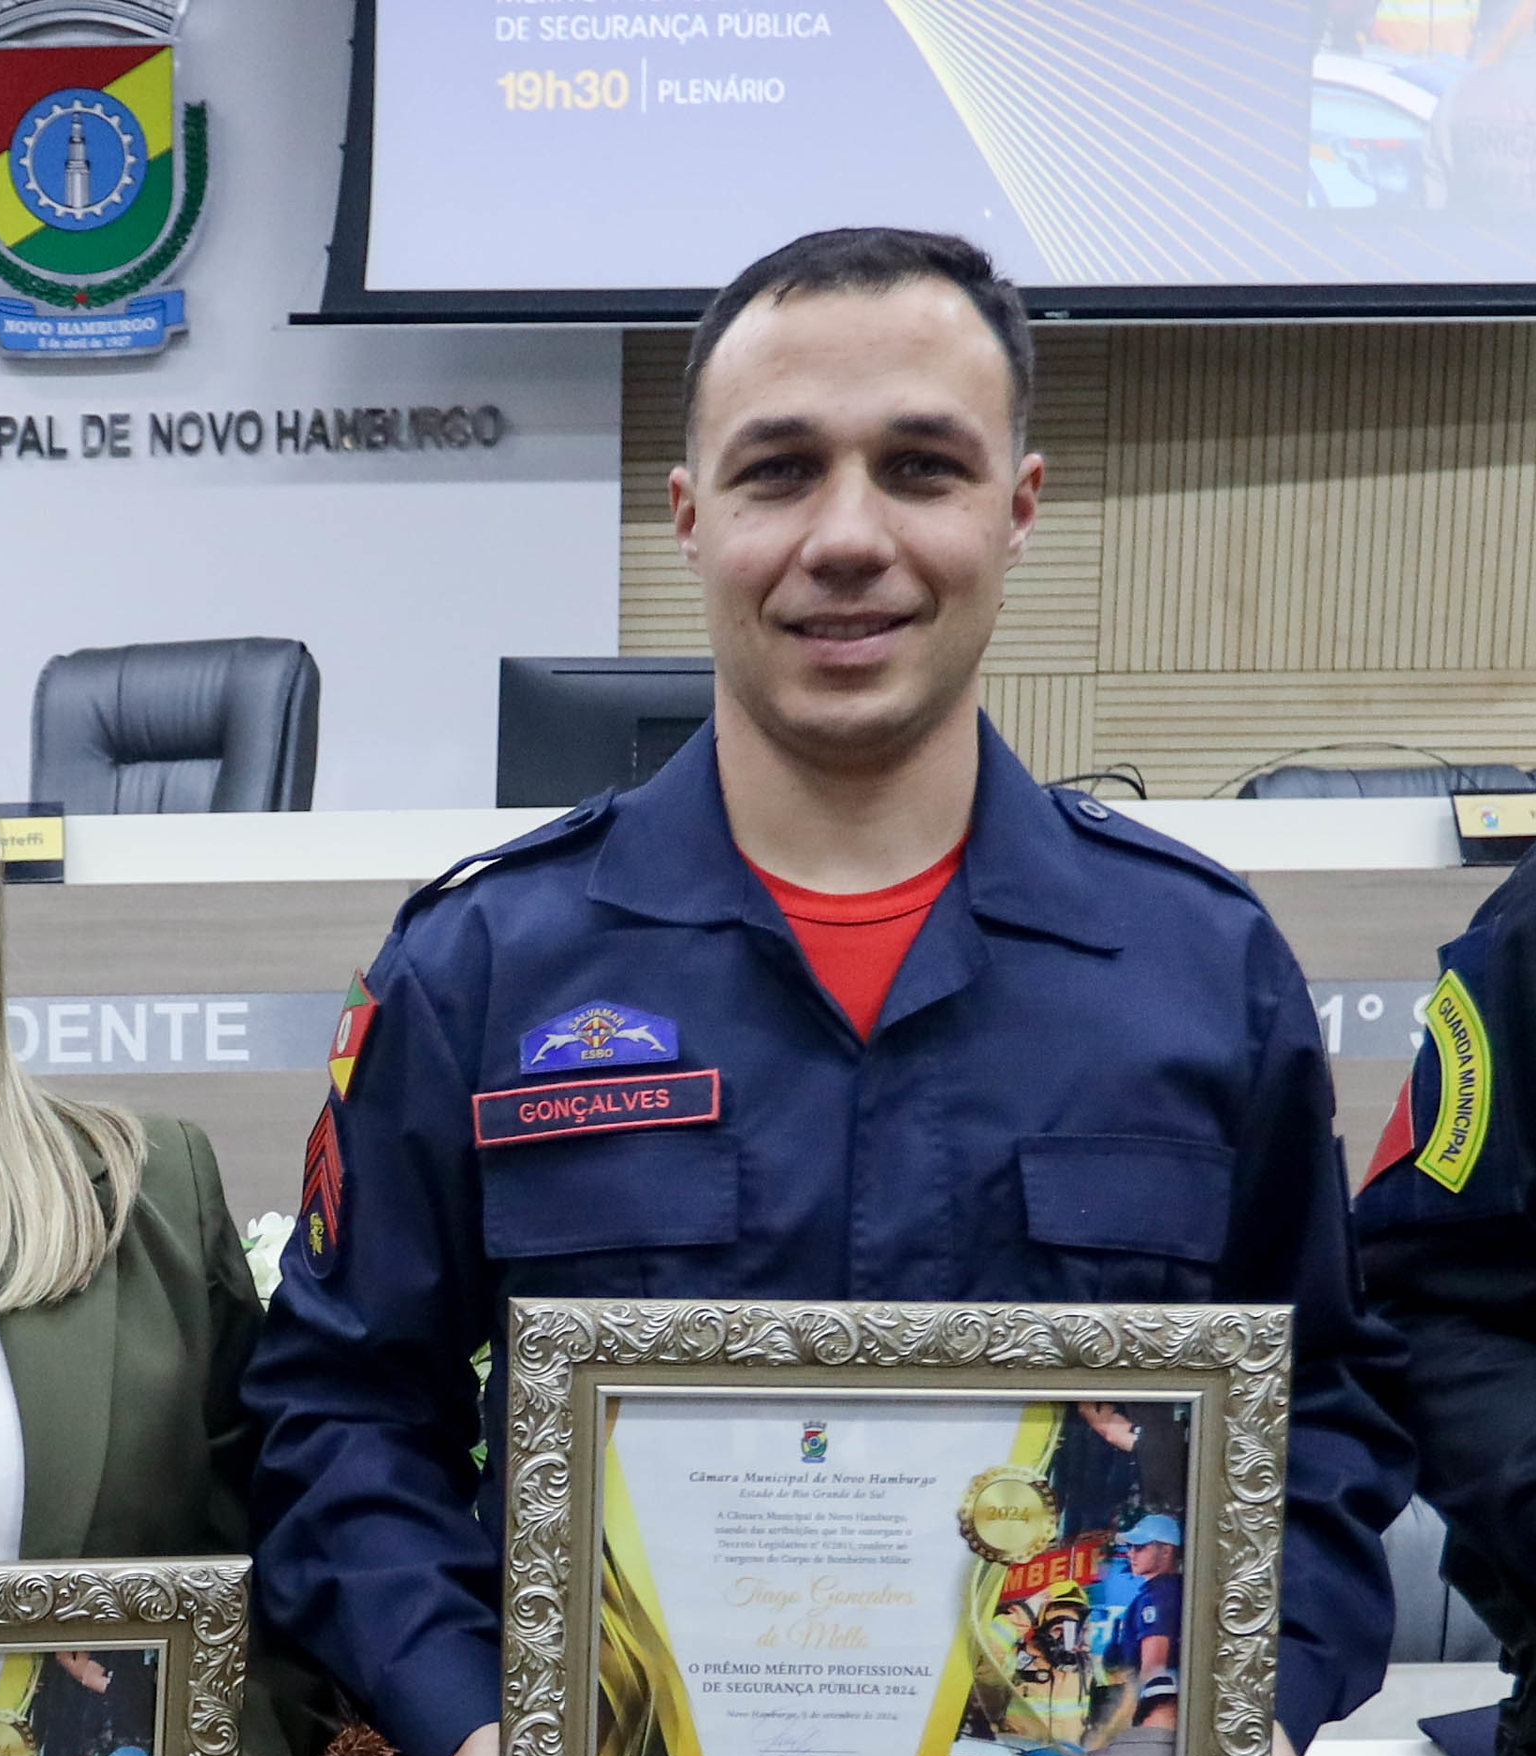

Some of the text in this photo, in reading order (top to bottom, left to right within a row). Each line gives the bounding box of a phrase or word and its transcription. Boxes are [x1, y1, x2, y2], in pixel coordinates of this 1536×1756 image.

[495, 10, 831, 45] DE SEGURANÇA PÚBLICA
[497, 69, 786, 111] 19h30 PLENÁRIO
[3, 317, 157, 335] NOVO HAMBURGO
[81, 413, 131, 458] DE
[149, 409, 264, 458] NOVO
[276, 404, 504, 455] HAMBURGO
[569, 1008, 625, 1032] SALVAMAR
[581, 1050, 613, 1060] ESBO
[1438, 997, 1475, 1164] GUARDA MUNICIPAL
[519, 1089, 670, 1123] GONÇALVES
[689, 1472, 936, 1487] Câmara Municipal de Novo Hamburgo
[689, 1661, 932, 1676] O PRÊMIO MÉRITO PROFISSIONAL
[703, 1683, 916, 1696] DE SEGURANÇA PÚBLICA 2024
